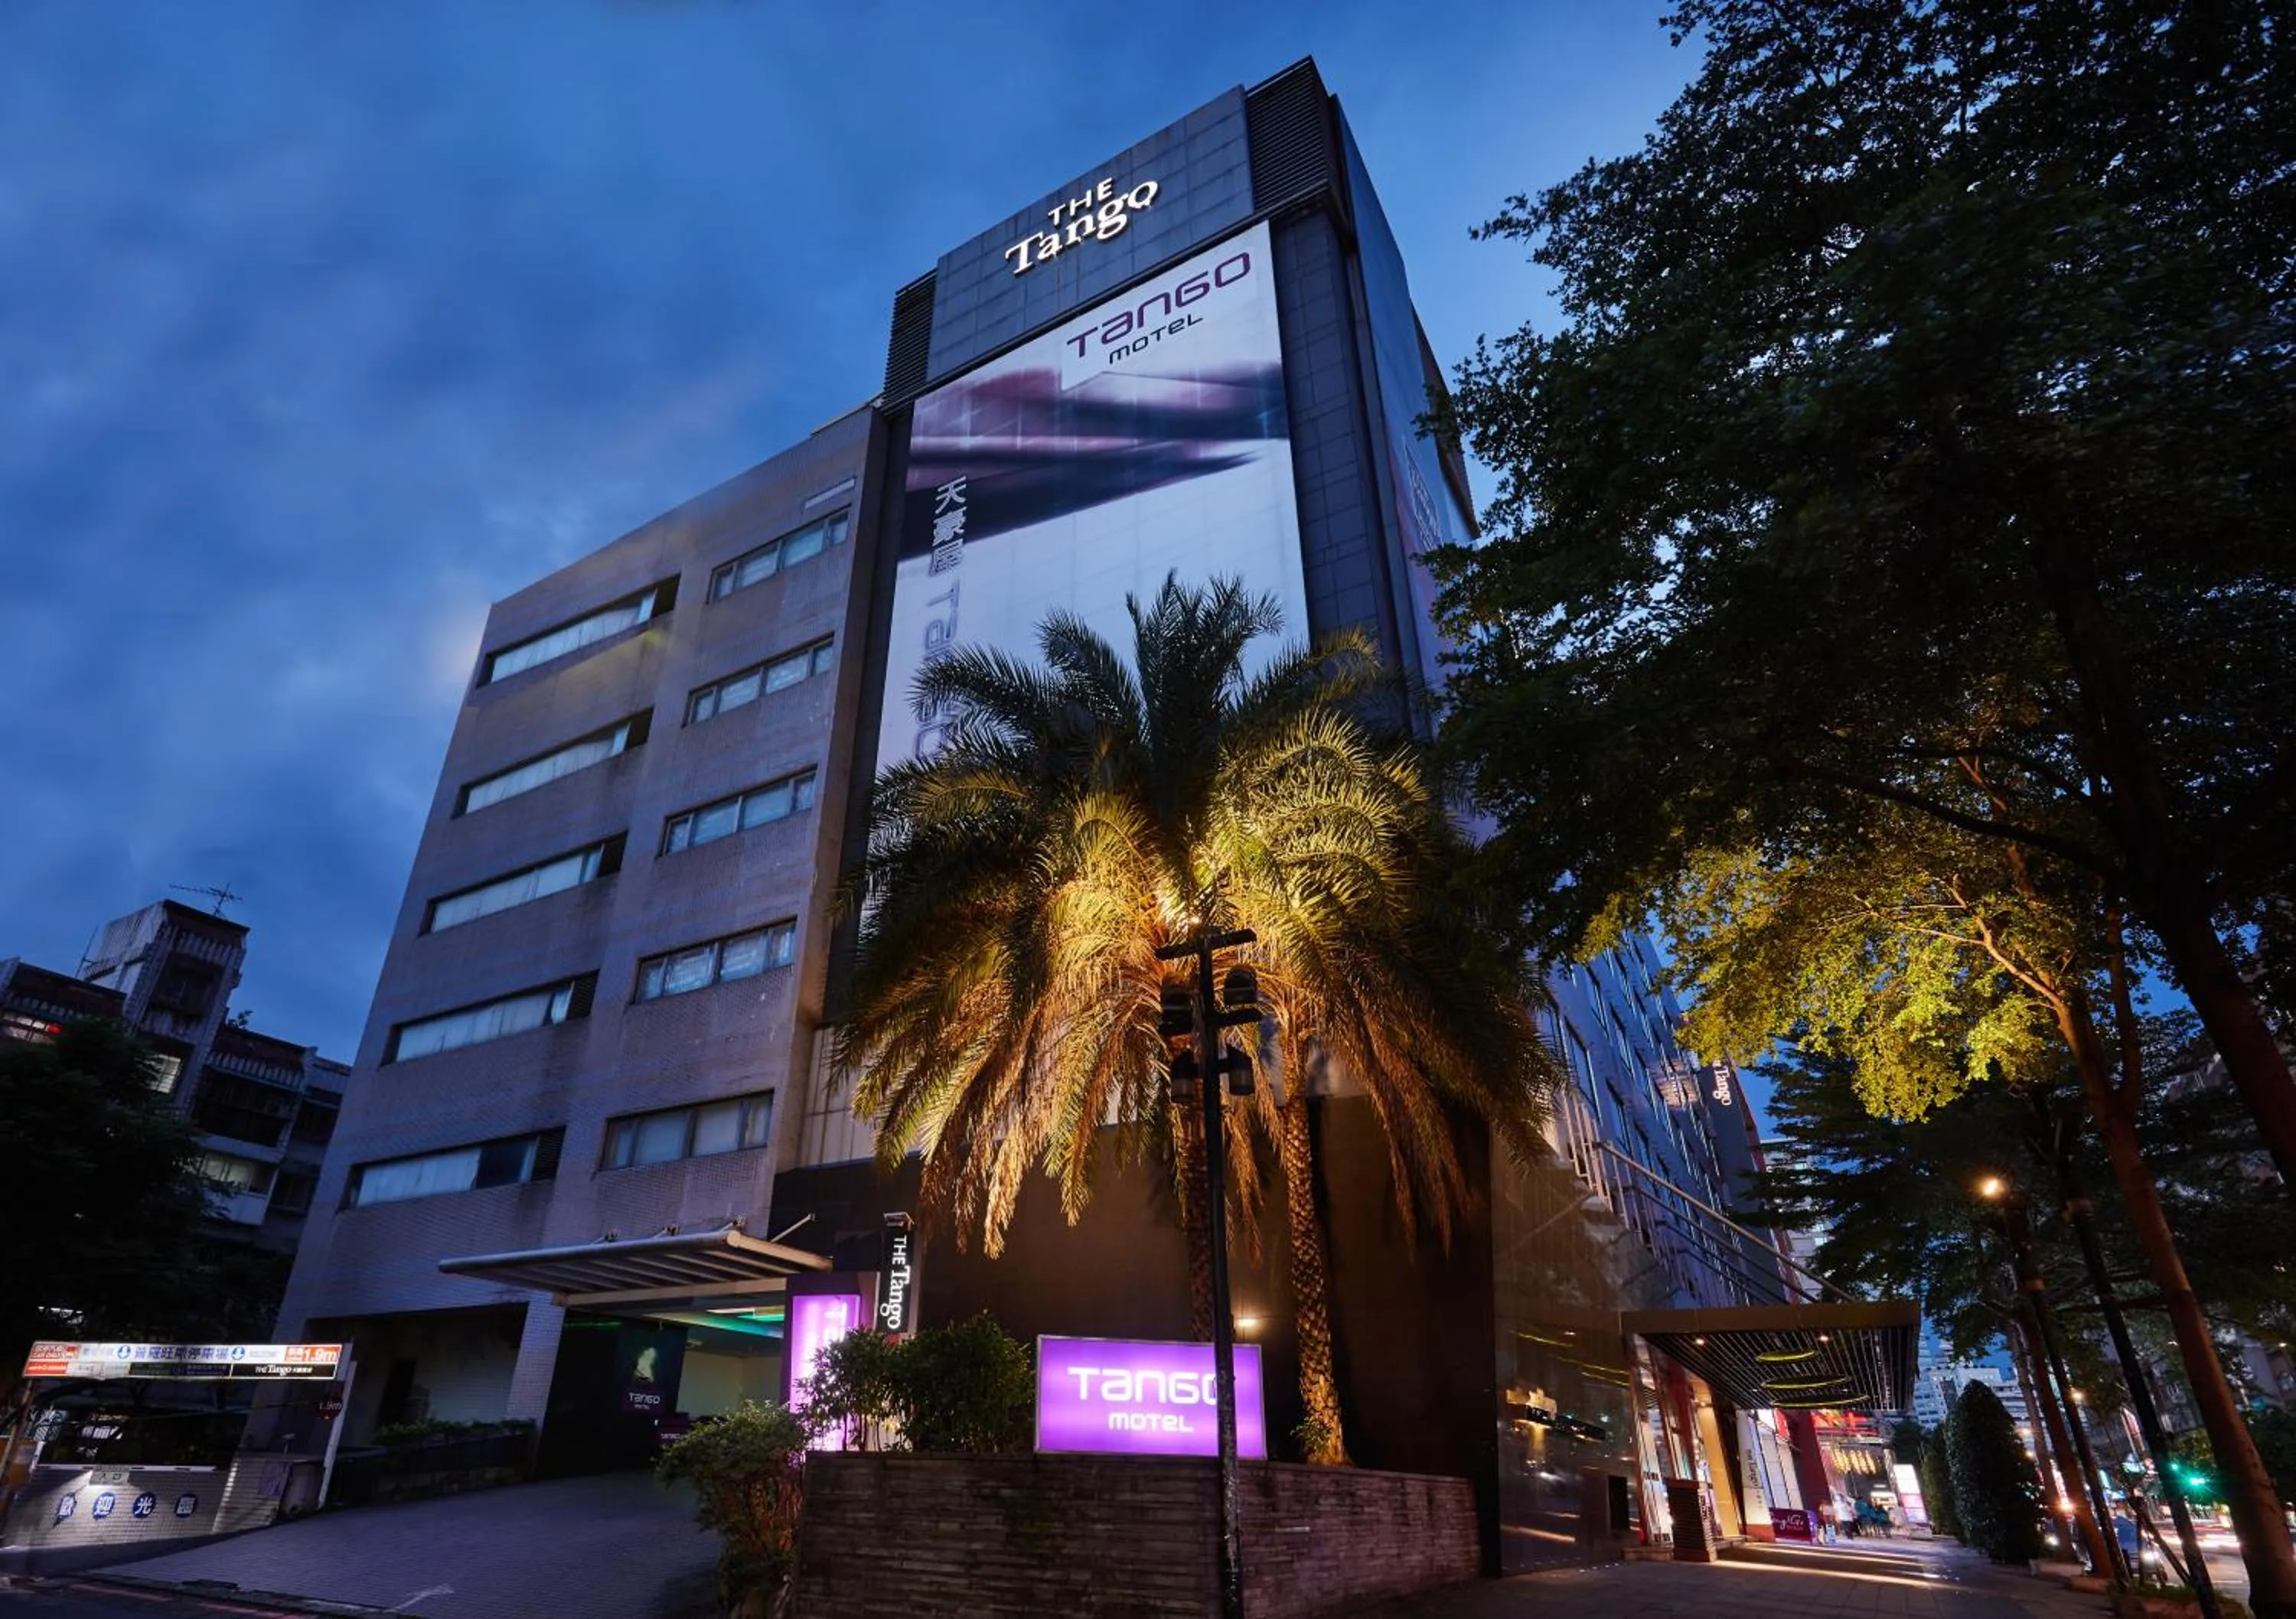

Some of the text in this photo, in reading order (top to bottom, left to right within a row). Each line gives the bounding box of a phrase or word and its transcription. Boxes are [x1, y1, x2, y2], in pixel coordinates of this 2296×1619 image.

[1005, 181, 1158, 274] Tango
[1048, 177, 1113, 226] THE
[880, 1233, 911, 1330] THE Tango
[305, 1347, 338, 1362] 1.9m
